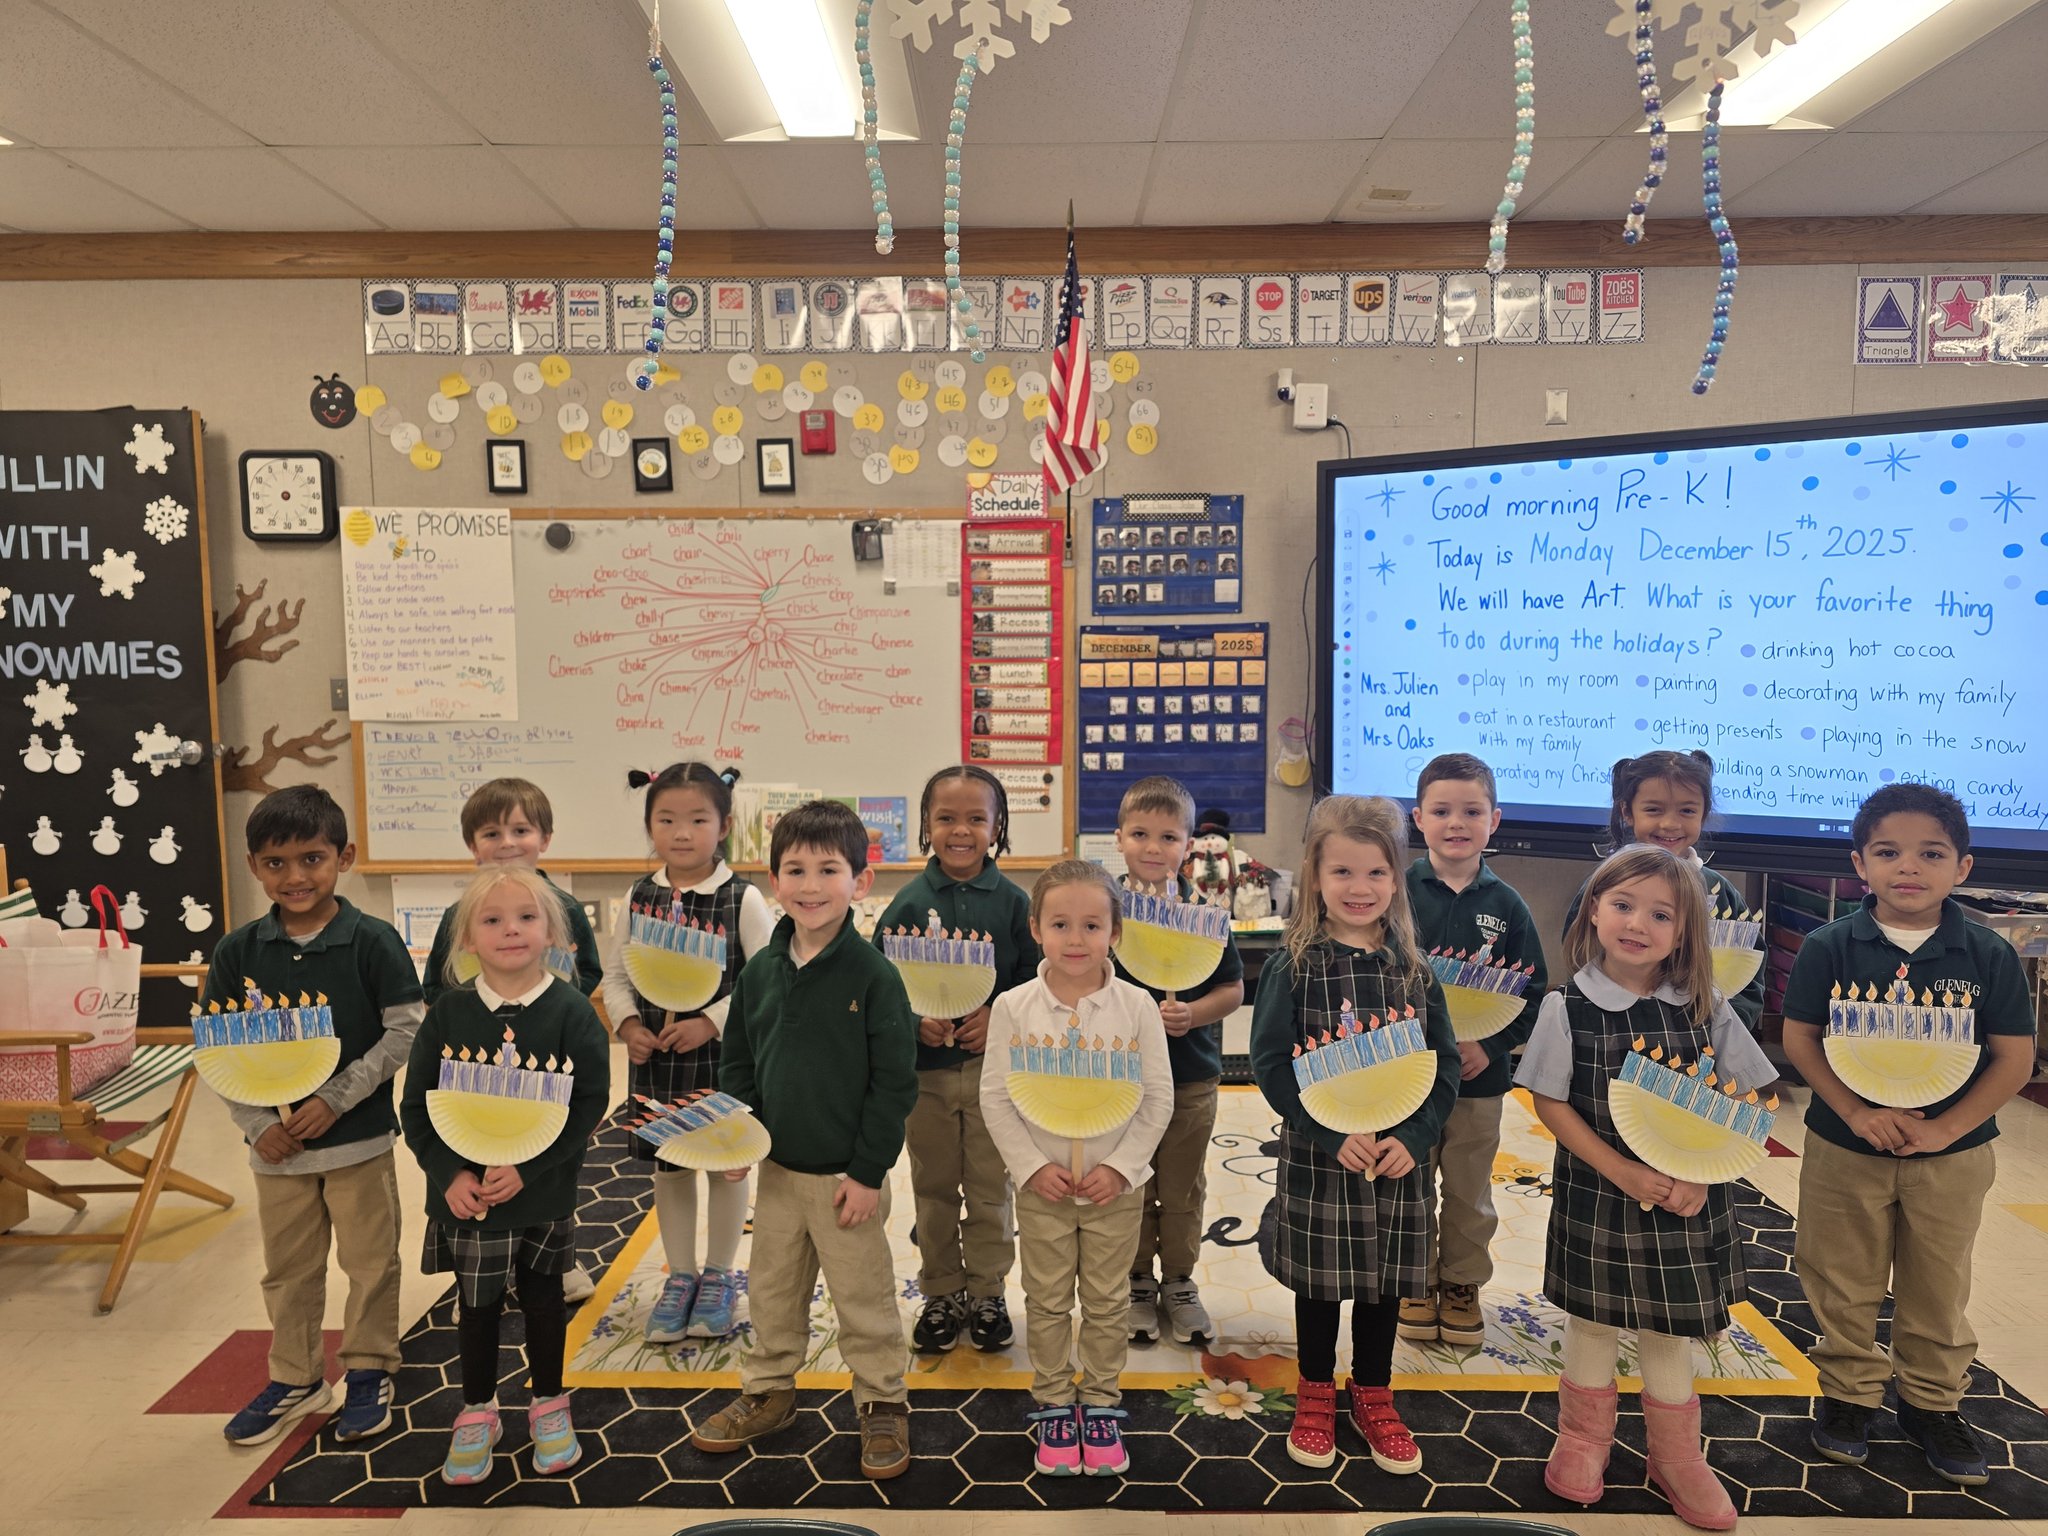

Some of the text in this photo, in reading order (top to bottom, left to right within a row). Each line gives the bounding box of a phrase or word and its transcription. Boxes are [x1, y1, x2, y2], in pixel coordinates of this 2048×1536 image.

[570, 288, 599, 299] EXXON
[617, 295, 649, 309] FedEx
[1258, 291, 1282, 302] STOP
[1311, 289, 1341, 301] TARGET
[1354, 288, 1383, 309] ups
[1402, 293, 1433, 304] verizon
[1552, 282, 1586, 304] YouTube
[1606, 294, 1635, 305] KITCHEN
[569, 306, 599, 317] Mobil
[374, 322, 411, 350] Aa
[419, 322, 453, 350] Bb
[471, 322, 507, 349] Cc
[570, 323, 601, 349] Ee
[714, 320, 749, 346] Hh
[1004, 316, 1040, 344] Nn
[1110, 312, 1141, 346] Pp
[1151, 315, 1188, 347] Qq
[1206, 318, 1235, 345] Rr
[1258, 316, 1282, 342] Ss
[1307, 316, 1332, 342] Tt
[1351, 316, 1386, 343] Uu
[1399, 315, 1430, 341] Vv
[1553, 310, 1585, 342] Yy
[1604, 313, 1638, 339] Zz
[1864, 346, 1909, 358] Triangle
[942, 368, 960, 381] 45
[1113, 357, 1135, 373] 64
[268, 465, 273, 473] 5
[294, 465, 304, 473] 55
[255, 476, 263, 484] 10
[307, 476, 316, 485] 50
[1001, 480, 1040, 498] Daily
[252, 492, 260, 500] 15
[311, 492, 320, 500] 45
[975, 497, 1040, 511] Schedule
[256, 506, 264, 515] 20
[308, 507, 317, 515] 40
[1432, 486, 1490, 521] Good
[1507, 489, 1599, 531] morning
[268, 518, 276, 527] 25
[283, 522, 292, 530] 30
[299, 518, 307, 527] 35
[375, 513, 510, 537] WE PROMISE
[412, 541, 436, 563] to
[996, 538, 1034, 547] Arrival
[1428, 539, 1483, 581] Today
[1497, 545, 1513, 566] is
[1530, 531, 1614, 576] Monday
[1639, 528, 1753, 561] December
[1822, 526, 1917, 558] 2025.
[12, 594, 75, 628] MY
[1439, 578, 1994, 637] We will have Art. What is your favorite thing
[1000, 616, 1041, 627] Recess
[1091, 640, 1254, 653] DECEMBER 2025
[1438, 622, 1459, 649] to
[1465, 630, 1486, 650] do
[1500, 629, 1559, 661] during
[1570, 628, 1603, 650] the
[1762, 638, 1956, 668] drinking hot cocoa
[1000, 668, 1033, 678] Lunch
[1472, 669, 1619, 696] play in my room
[1361, 672, 1439, 696] Mrs. Julien
[1654, 675, 1718, 704] painting
[1006, 694, 1031, 703] Rest
[1764, 678, 2017, 717] decorating with my family
[1385, 701, 1411, 718] and
[1474, 708, 1616, 730] eat in a restaurant
[1009, 719, 1028, 728] Art
[1653, 715, 1783, 748] getting presents
[1397, 724, 1435, 750] Oaks
[1516, 736, 1535, 755] my
[1541, 733, 1582, 762] family
[1823, 725, 2027, 757] playing in the snow
[1545, 768, 1564, 789] my
[1770, 765, 1782, 776] a
[1788, 764, 1869, 783] snowman
[1786, 785, 1825, 805] time
[1967, 778, 2023, 803] candy
[1987, 801, 2048, 830] daddy
[1476, 914, 1507, 933] GLENELG
[1934, 978, 1981, 997] GLENELG
